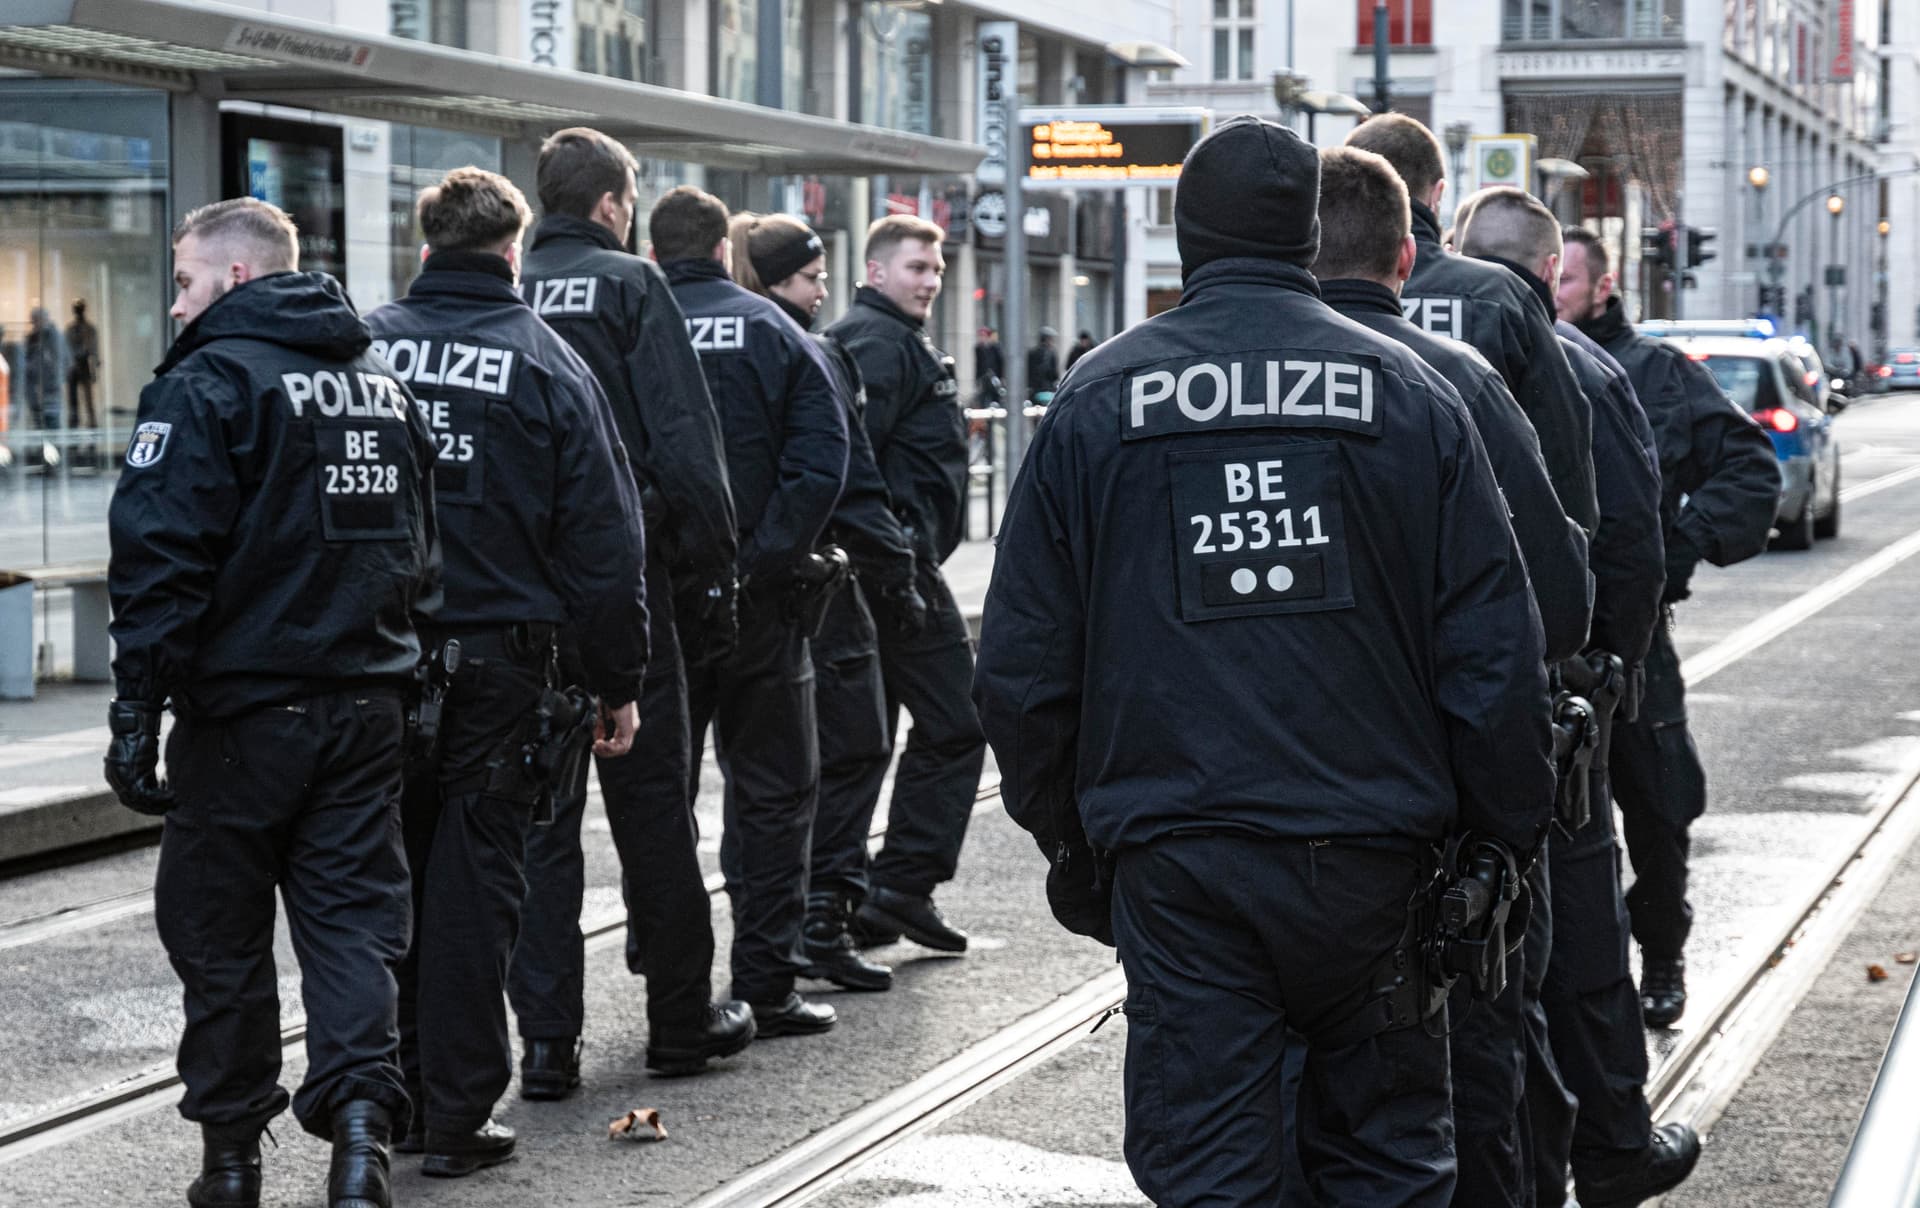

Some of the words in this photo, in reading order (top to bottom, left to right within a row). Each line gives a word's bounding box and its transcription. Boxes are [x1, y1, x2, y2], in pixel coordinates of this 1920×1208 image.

[519, 277, 597, 315] IZEI
[685, 316, 744, 349] ZEI
[1131, 360, 1374, 428] POLIZEI
[345, 430, 379, 460] BE
[430, 432, 475, 462] 25
[325, 464, 399, 494] 25328
[1224, 460, 1286, 503] BE
[1190, 505, 1330, 554] 25311
